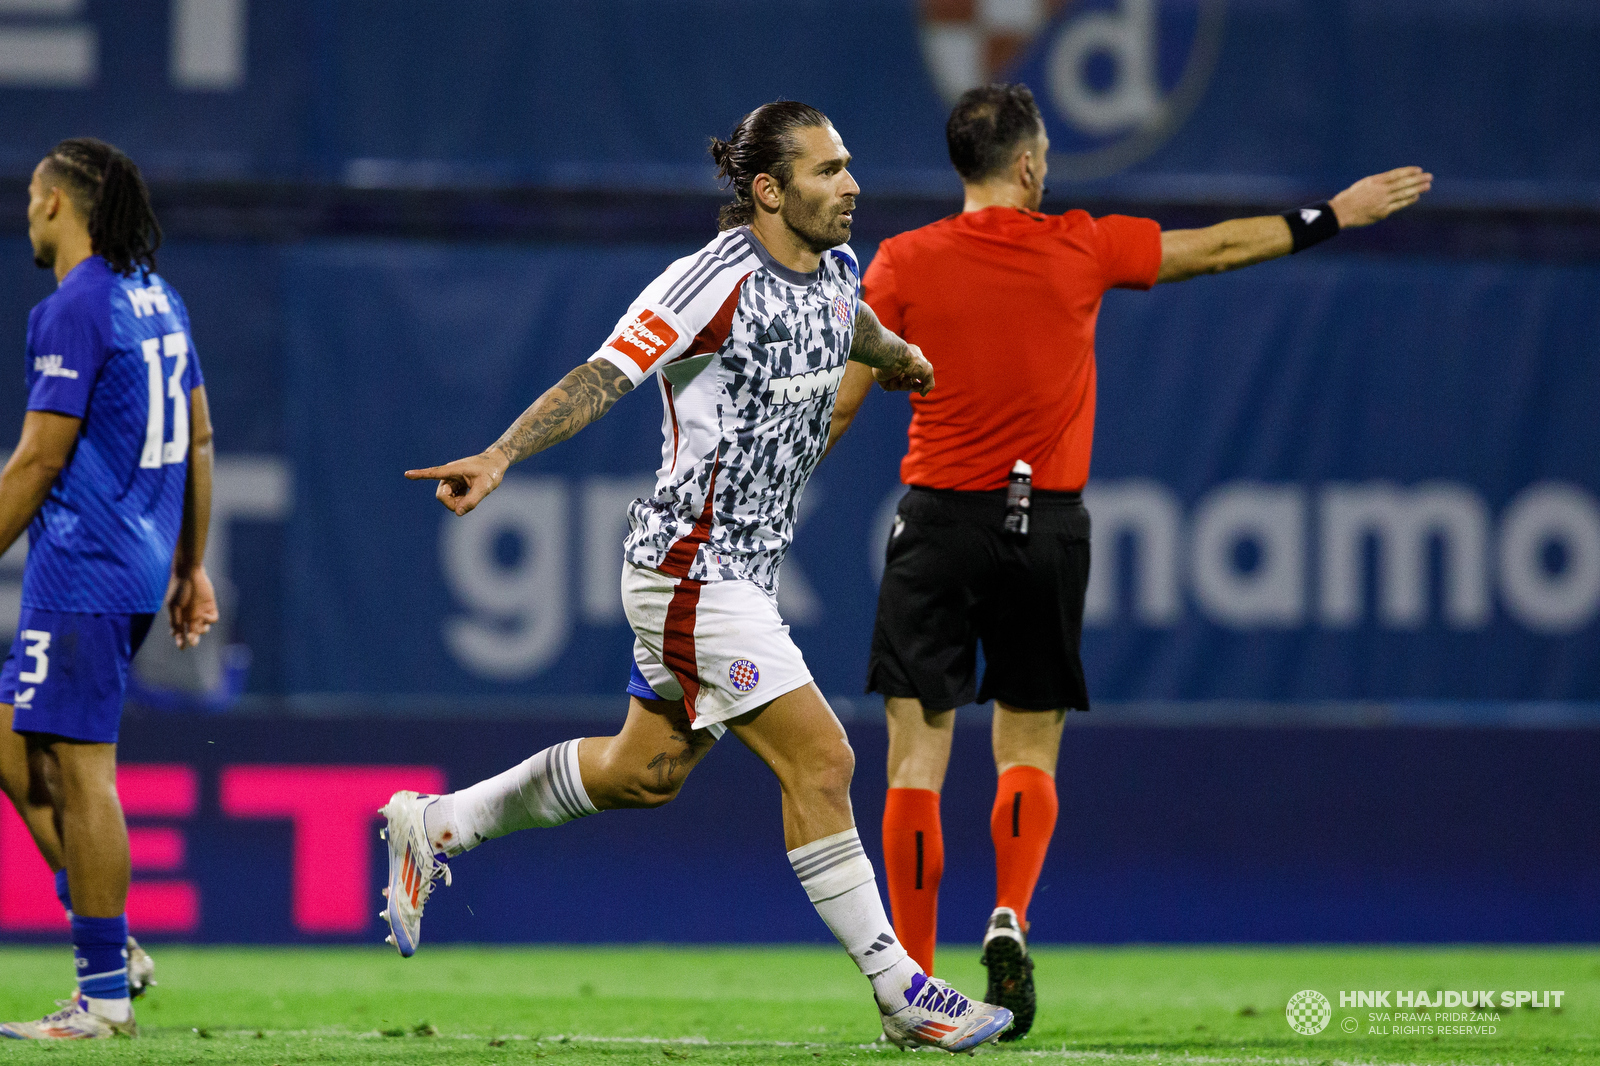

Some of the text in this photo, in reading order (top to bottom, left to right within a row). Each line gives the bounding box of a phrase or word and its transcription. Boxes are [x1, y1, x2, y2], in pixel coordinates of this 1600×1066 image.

[768, 365, 846, 406] TOMM
[139, 331, 188, 469] 13
[730, 660, 752, 675] HAJDUK
[739, 680, 757, 691] SPLIT
